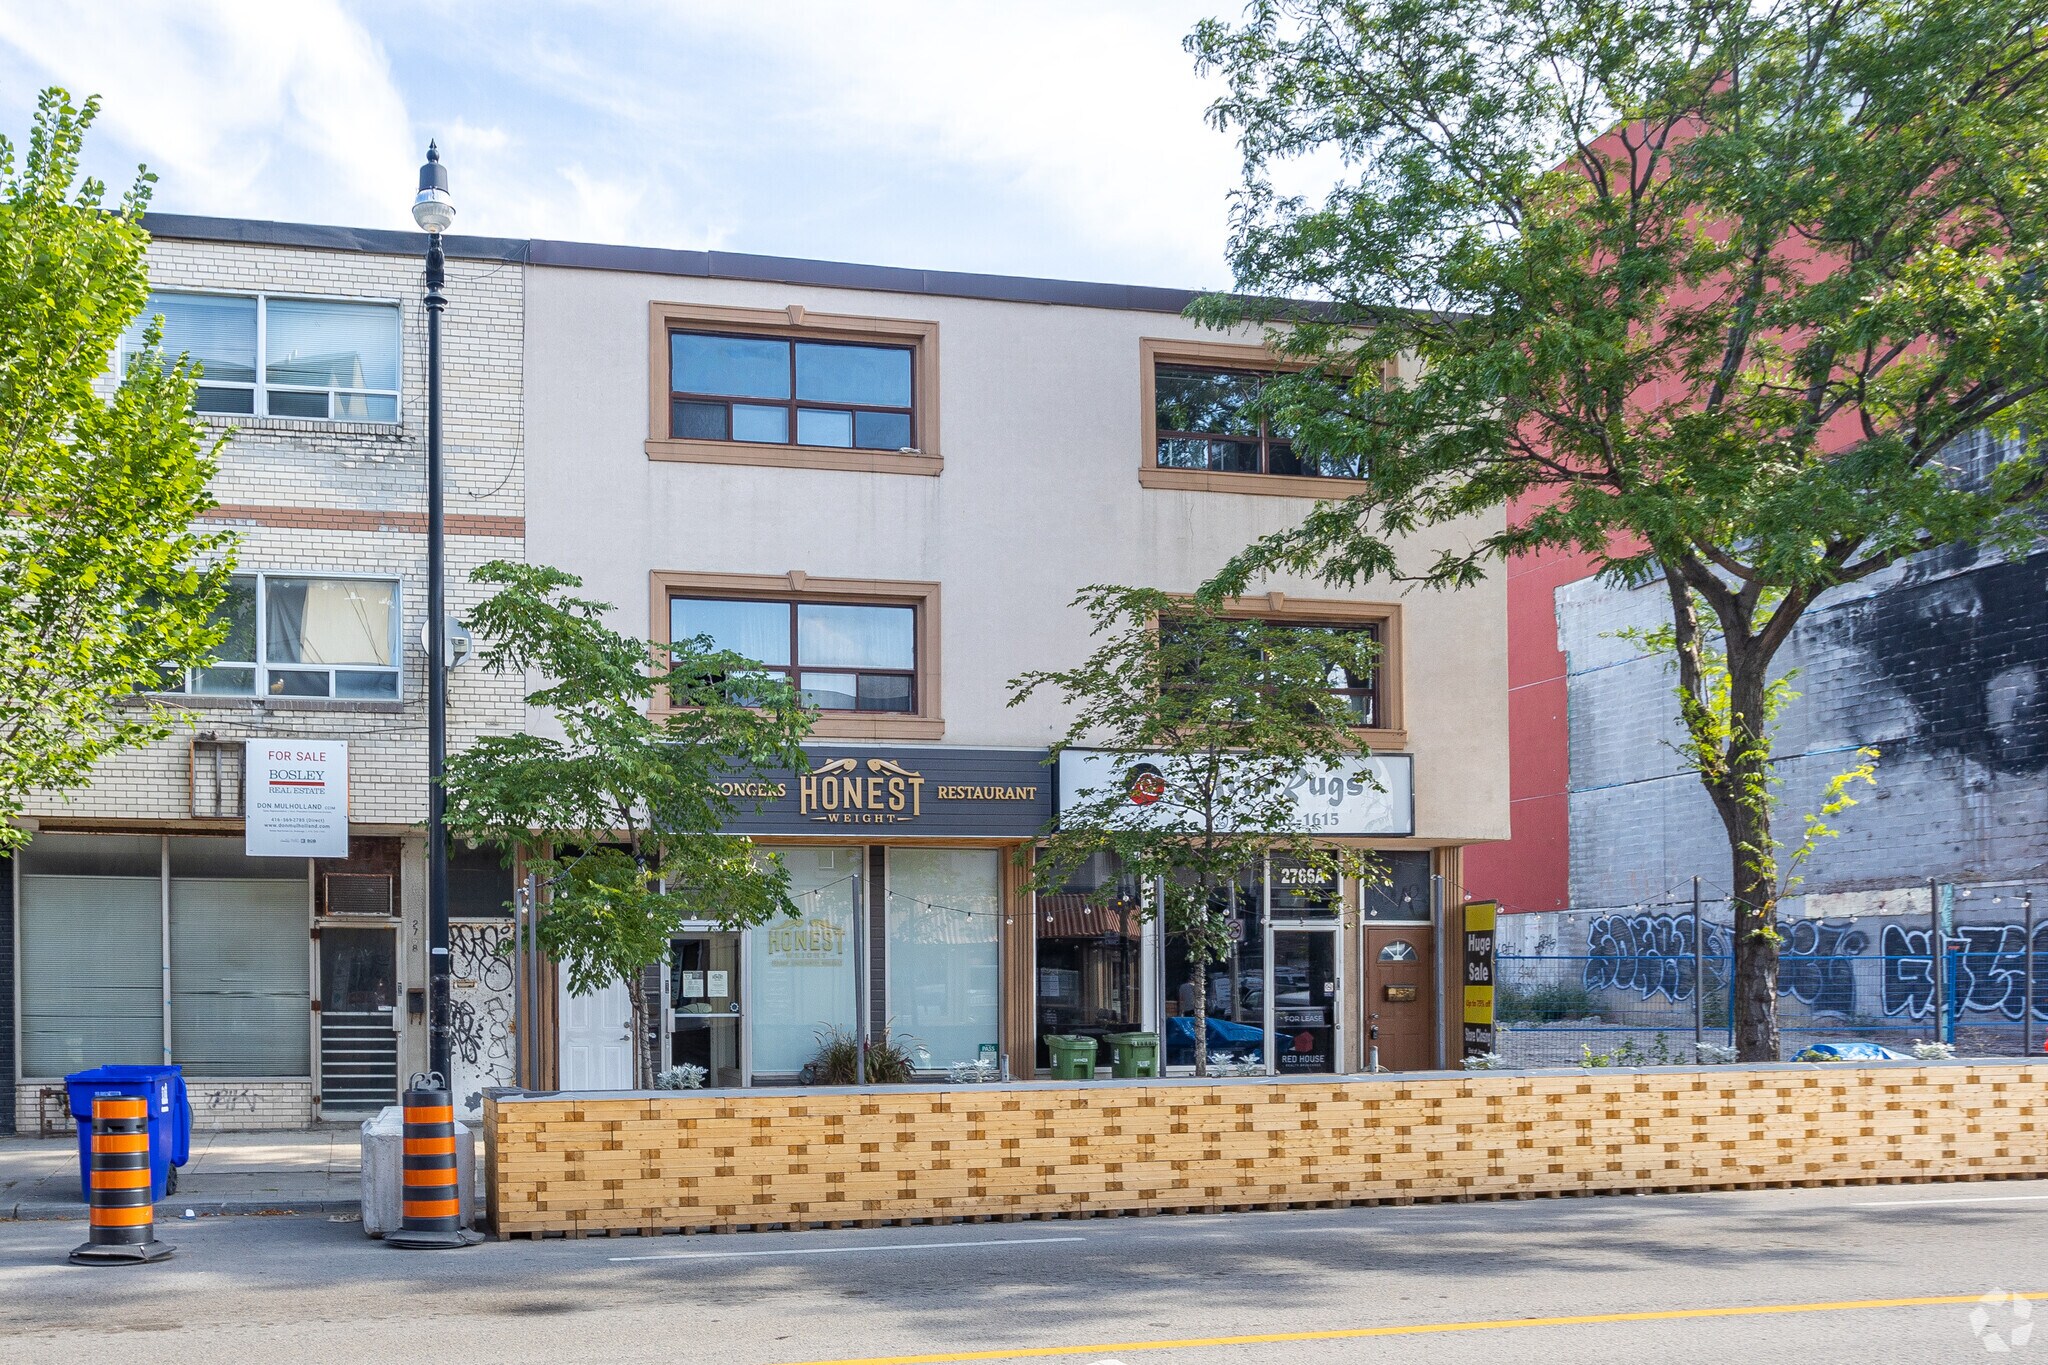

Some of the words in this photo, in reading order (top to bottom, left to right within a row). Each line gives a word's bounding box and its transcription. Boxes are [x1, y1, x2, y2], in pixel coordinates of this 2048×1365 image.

[268, 750, 292, 761] FOR
[296, 751, 327, 762] SALE
[269, 769, 325, 781] BOSLEY
[269, 786, 292, 794] REAL
[293, 787, 326, 795] ESTATE
[937, 785, 1037, 801] RESTAURANT
[1273, 766, 1364, 807] Rugs
[799, 775, 925, 816] HONEST
[828, 813, 896, 823] WEIGHT
[1281, 867, 1326, 884] 2766A
[768, 929, 846, 955] HONEST
[1468, 933, 1491, 956] Huge
[1468, 962, 1489, 981] Sale
[1285, 1015, 1300, 1023] FOR
[981, 1044, 996, 1052] PASS
[1281, 1055, 1298, 1063] RED
[1299, 1054, 1325, 1063] HOUSE
